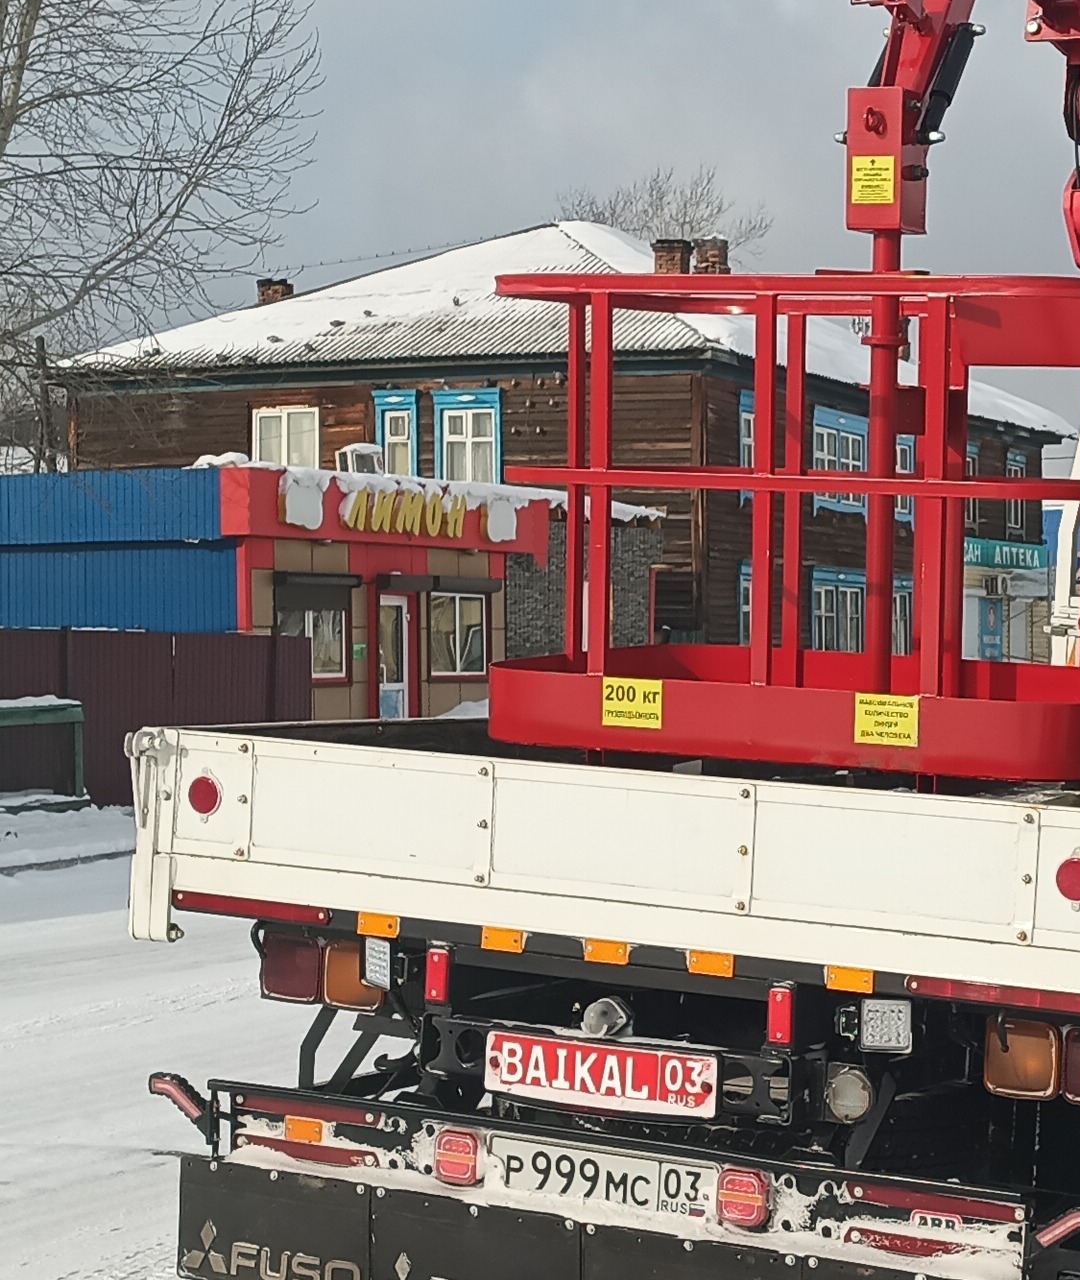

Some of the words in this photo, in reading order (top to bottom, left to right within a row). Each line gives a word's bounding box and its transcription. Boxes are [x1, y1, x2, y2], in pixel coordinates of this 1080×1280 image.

[346, 486, 467, 538] ЛИМОН
[994, 545, 1040, 568] АПТЕКА
[605, 684, 636, 702] 200
[501, 1041, 649, 1100] BAIKAL
[664, 1058, 703, 1095] 03
[667, 1094, 696, 1109] RUS
[663, 1168, 702, 1203] 03
[660, 1199, 688, 1215] RUS
